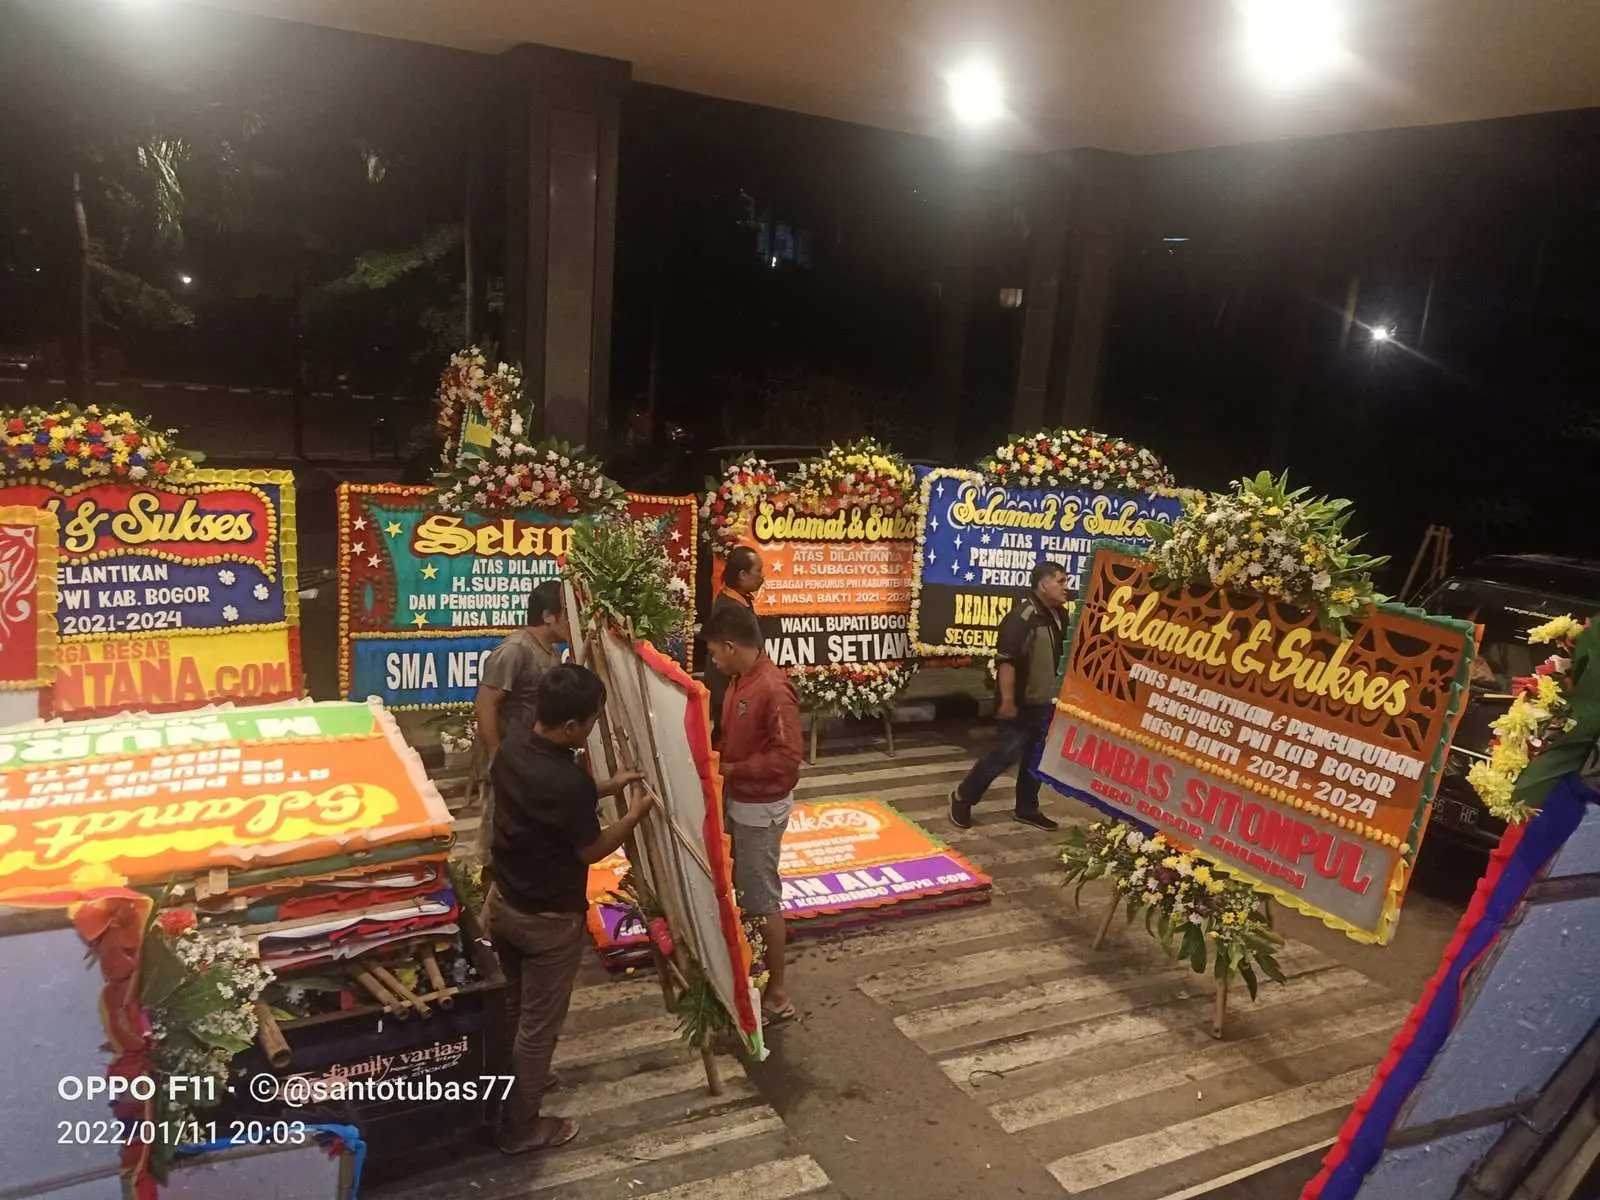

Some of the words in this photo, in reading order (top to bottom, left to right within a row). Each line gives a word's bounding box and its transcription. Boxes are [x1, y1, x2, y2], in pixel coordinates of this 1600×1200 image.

[65, 501, 109, 552] &
[112, 493, 252, 543] Sukses
[755, 501, 847, 540] Selamat
[848, 506, 864, 539] &
[865, 504, 915, 541] Suks
[953, 488, 1055, 532] Selamat
[1060, 503, 1082, 532] &
[1083, 496, 1153, 537] Suks
[1000, 532, 1033, 548] ATAS
[1041, 536, 1091, 552] PELANTI
[472, 559, 503, 575] ATAS
[508, 559, 562, 575] DILANTI
[793, 551, 825, 562] ATAS
[969, 547, 1037, 570] PENGURUS
[1078, 555, 1087, 573] K
[56, 564, 168, 585] ELANTIKAN
[98, 588, 142, 608] KAB.
[145, 586, 210, 605] BOGOR
[409, 594, 436, 610] DAN
[440, 593, 510, 609] PENGURUS
[512, 594, 530, 610] PW
[782, 594, 813, 604] MASA
[816, 593, 852, 603] BAKTI
[63, 610, 182, 635] 2021-2024
[451, 610, 488, 627] MASA
[781, 617, 824, 633] WAKIL
[826, 614, 870, 632] BUPATI
[870, 614, 910, 629] BOGO
[56, 640, 92, 664] RGA
[102, 640, 171, 661] BESAR
[1101, 587, 1232, 666] Selamat
[1231, 619, 1271, 674] &
[1269, 627, 1411, 716] Sukses
[386, 652, 438, 690] SMA
[1129, 663, 1169, 690] ATAS
[1166, 669, 1272, 730] PELANTIKAN
[1285, 720, 1426, 781] PENGUKUHAN
[1146, 694, 1233, 738] PENGURUS
[1275, 739, 1317, 771] KAB
[1319, 753, 1397, 800] BOGOR
[241, 768, 330, 786] ATAS
[1140, 713, 1184, 747] MASA
[1184, 730, 1241, 767] BAKTI
[1246, 755, 1302, 792] 2021
[1312, 780, 1378, 820] 2024
[35, 784, 366, 858] Selamat
[782, 808, 870, 834] ukses
[1059, 724, 1176, 803] LAMBAS
[1181, 778, 1374, 896] SITOMPUL
[1136, 798, 1206, 841] BOGOR
[836, 866, 907, 893] ALI
[322, 1053, 394, 1081] family
[399, 1035, 469, 1065] variasi
